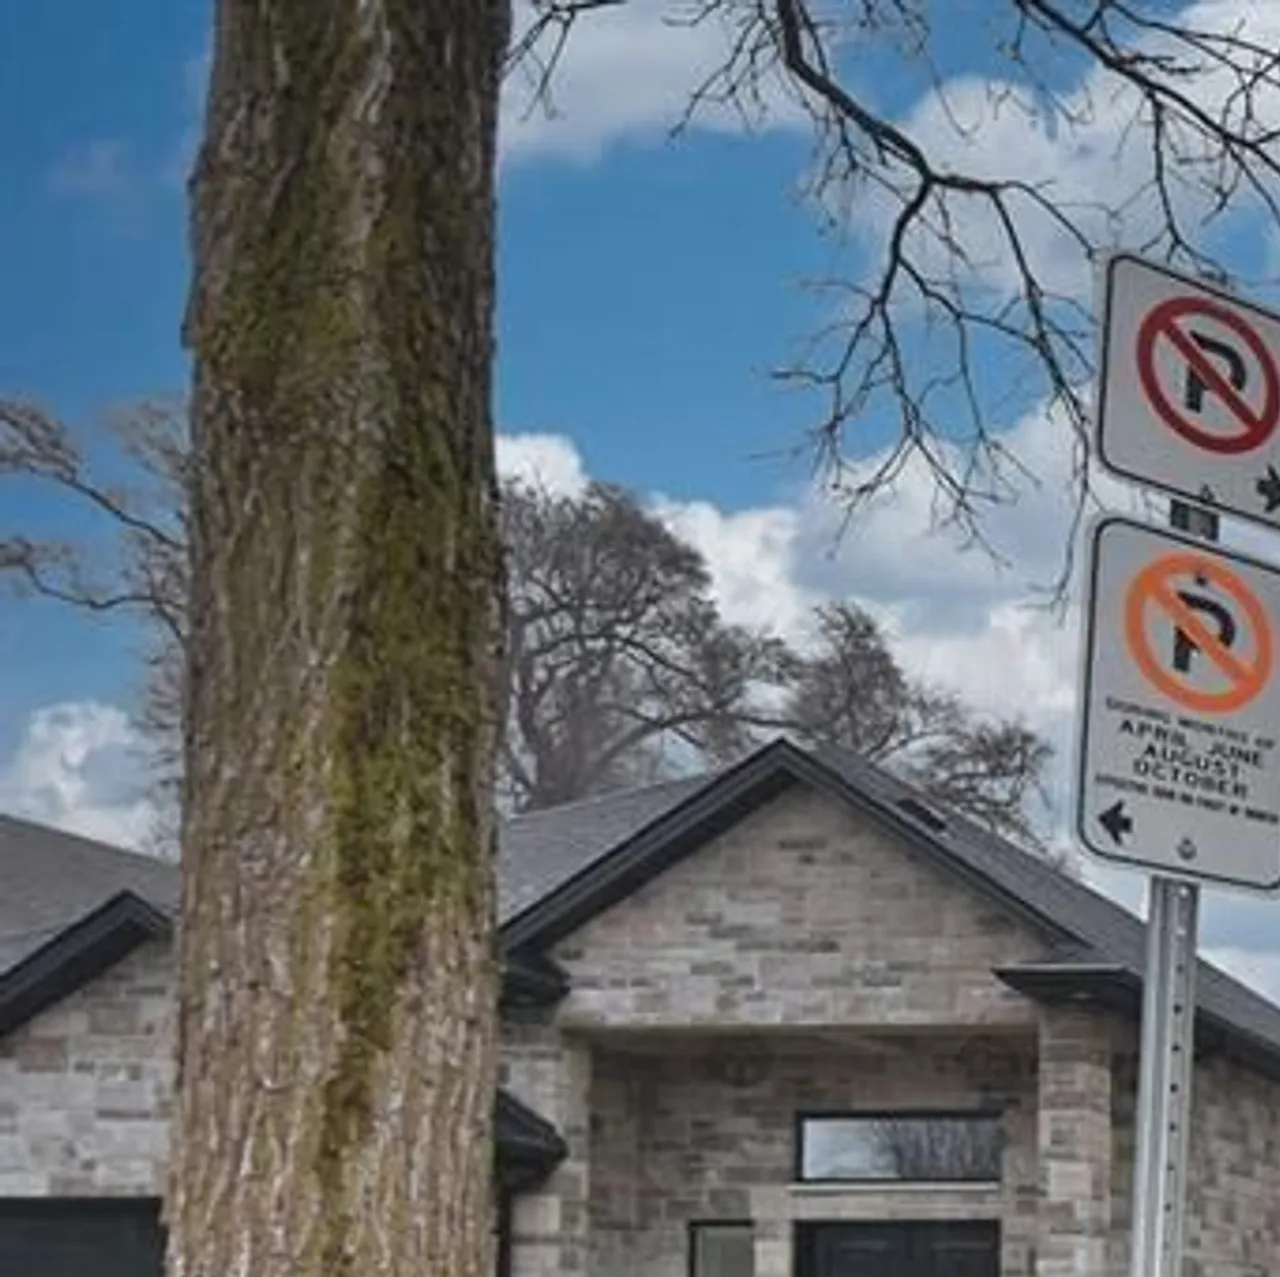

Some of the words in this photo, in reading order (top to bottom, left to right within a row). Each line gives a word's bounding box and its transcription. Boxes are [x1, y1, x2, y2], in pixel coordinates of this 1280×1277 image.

[1144, 744, 1240, 779] AUGUST
[1208, 743, 1263, 768] JUNE
[1132, 758, 1248, 799] OCTOBER
